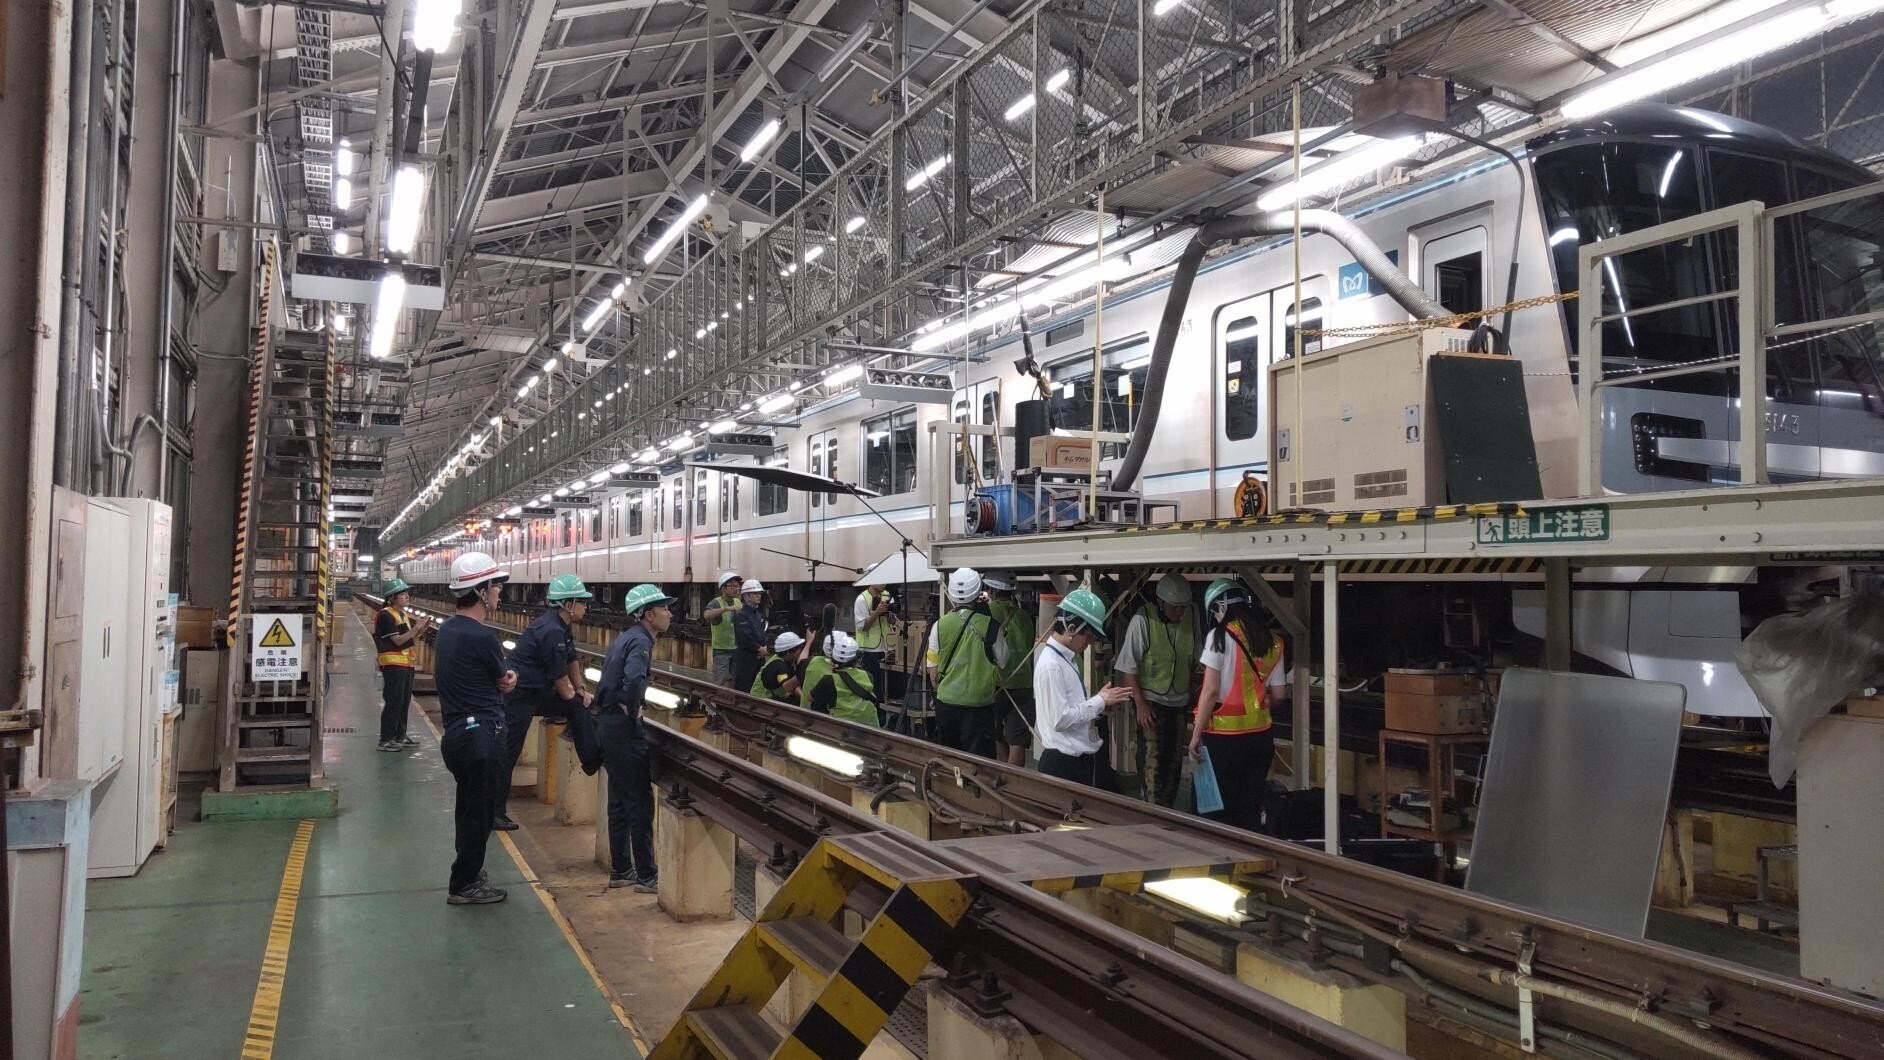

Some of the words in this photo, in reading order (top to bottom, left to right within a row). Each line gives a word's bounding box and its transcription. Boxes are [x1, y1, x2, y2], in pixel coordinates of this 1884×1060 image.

[1508, 509, 1605, 539] 頭上注意
[256, 657, 298, 667] 感電注意
